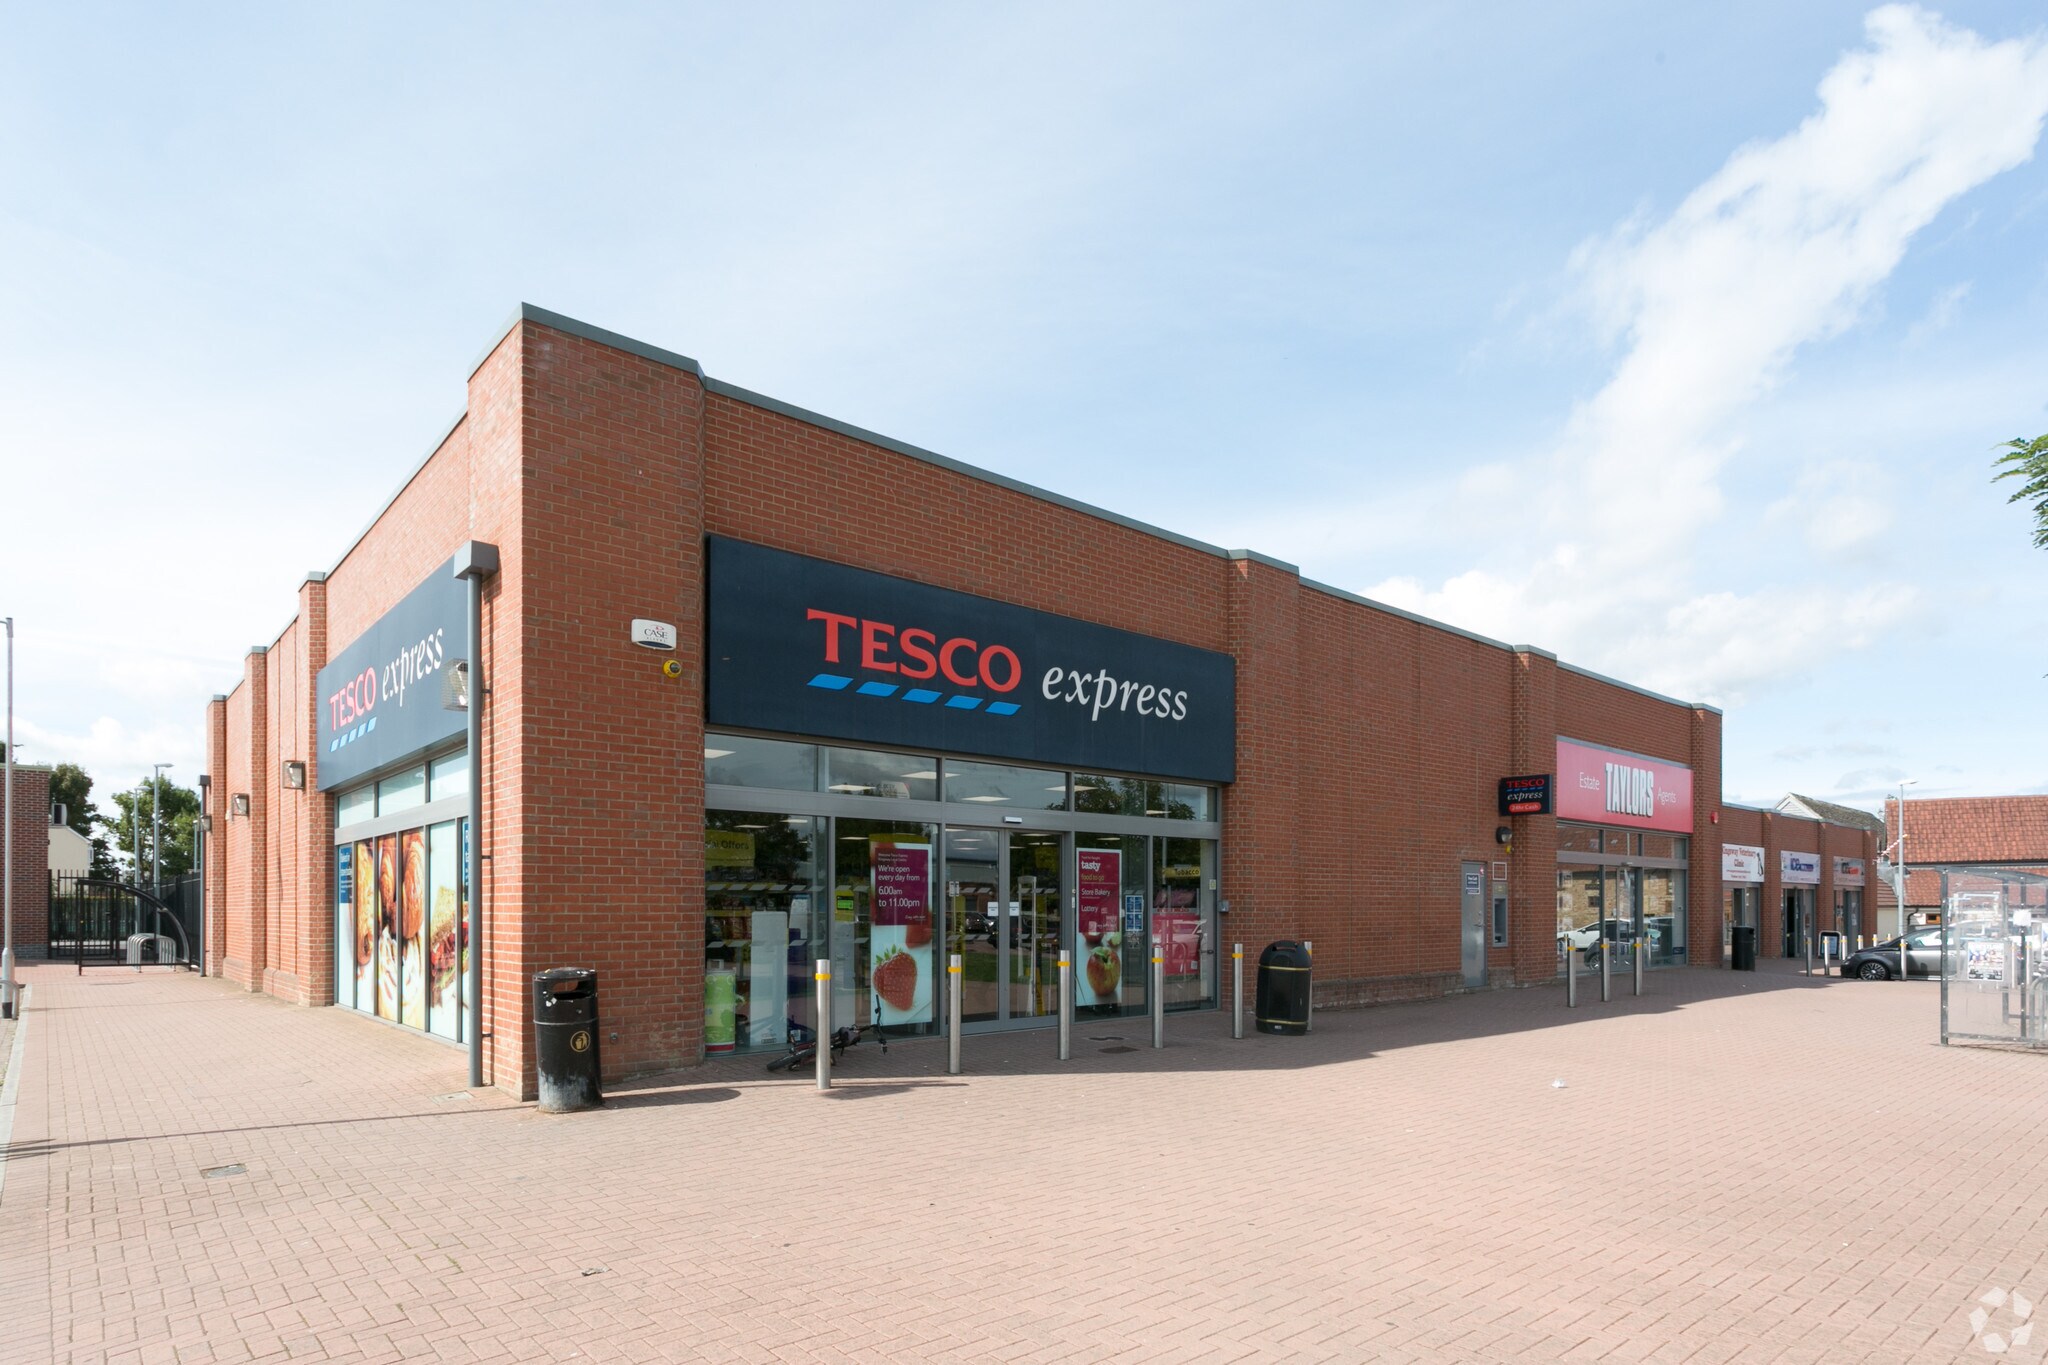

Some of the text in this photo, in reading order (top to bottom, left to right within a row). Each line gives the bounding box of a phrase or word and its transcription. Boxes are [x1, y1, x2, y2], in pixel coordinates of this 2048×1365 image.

[644, 628, 668, 639] CASE
[806, 608, 1188, 722] TESCO express
[329, 628, 443, 732] TESCO express
[1506, 778, 1545, 788] TESCO
[1579, 763, 1677, 817] Estate TAYLORS Agents
[1507, 791, 1543, 802] express
[1081, 861, 1101, 872] tasty
[1174, 867, 1200, 876] Tobacco
[895, 874, 905, 883] day
[1081, 887, 1111, 897] Store Bakery
[878, 898, 920, 909] to 11.00pm
